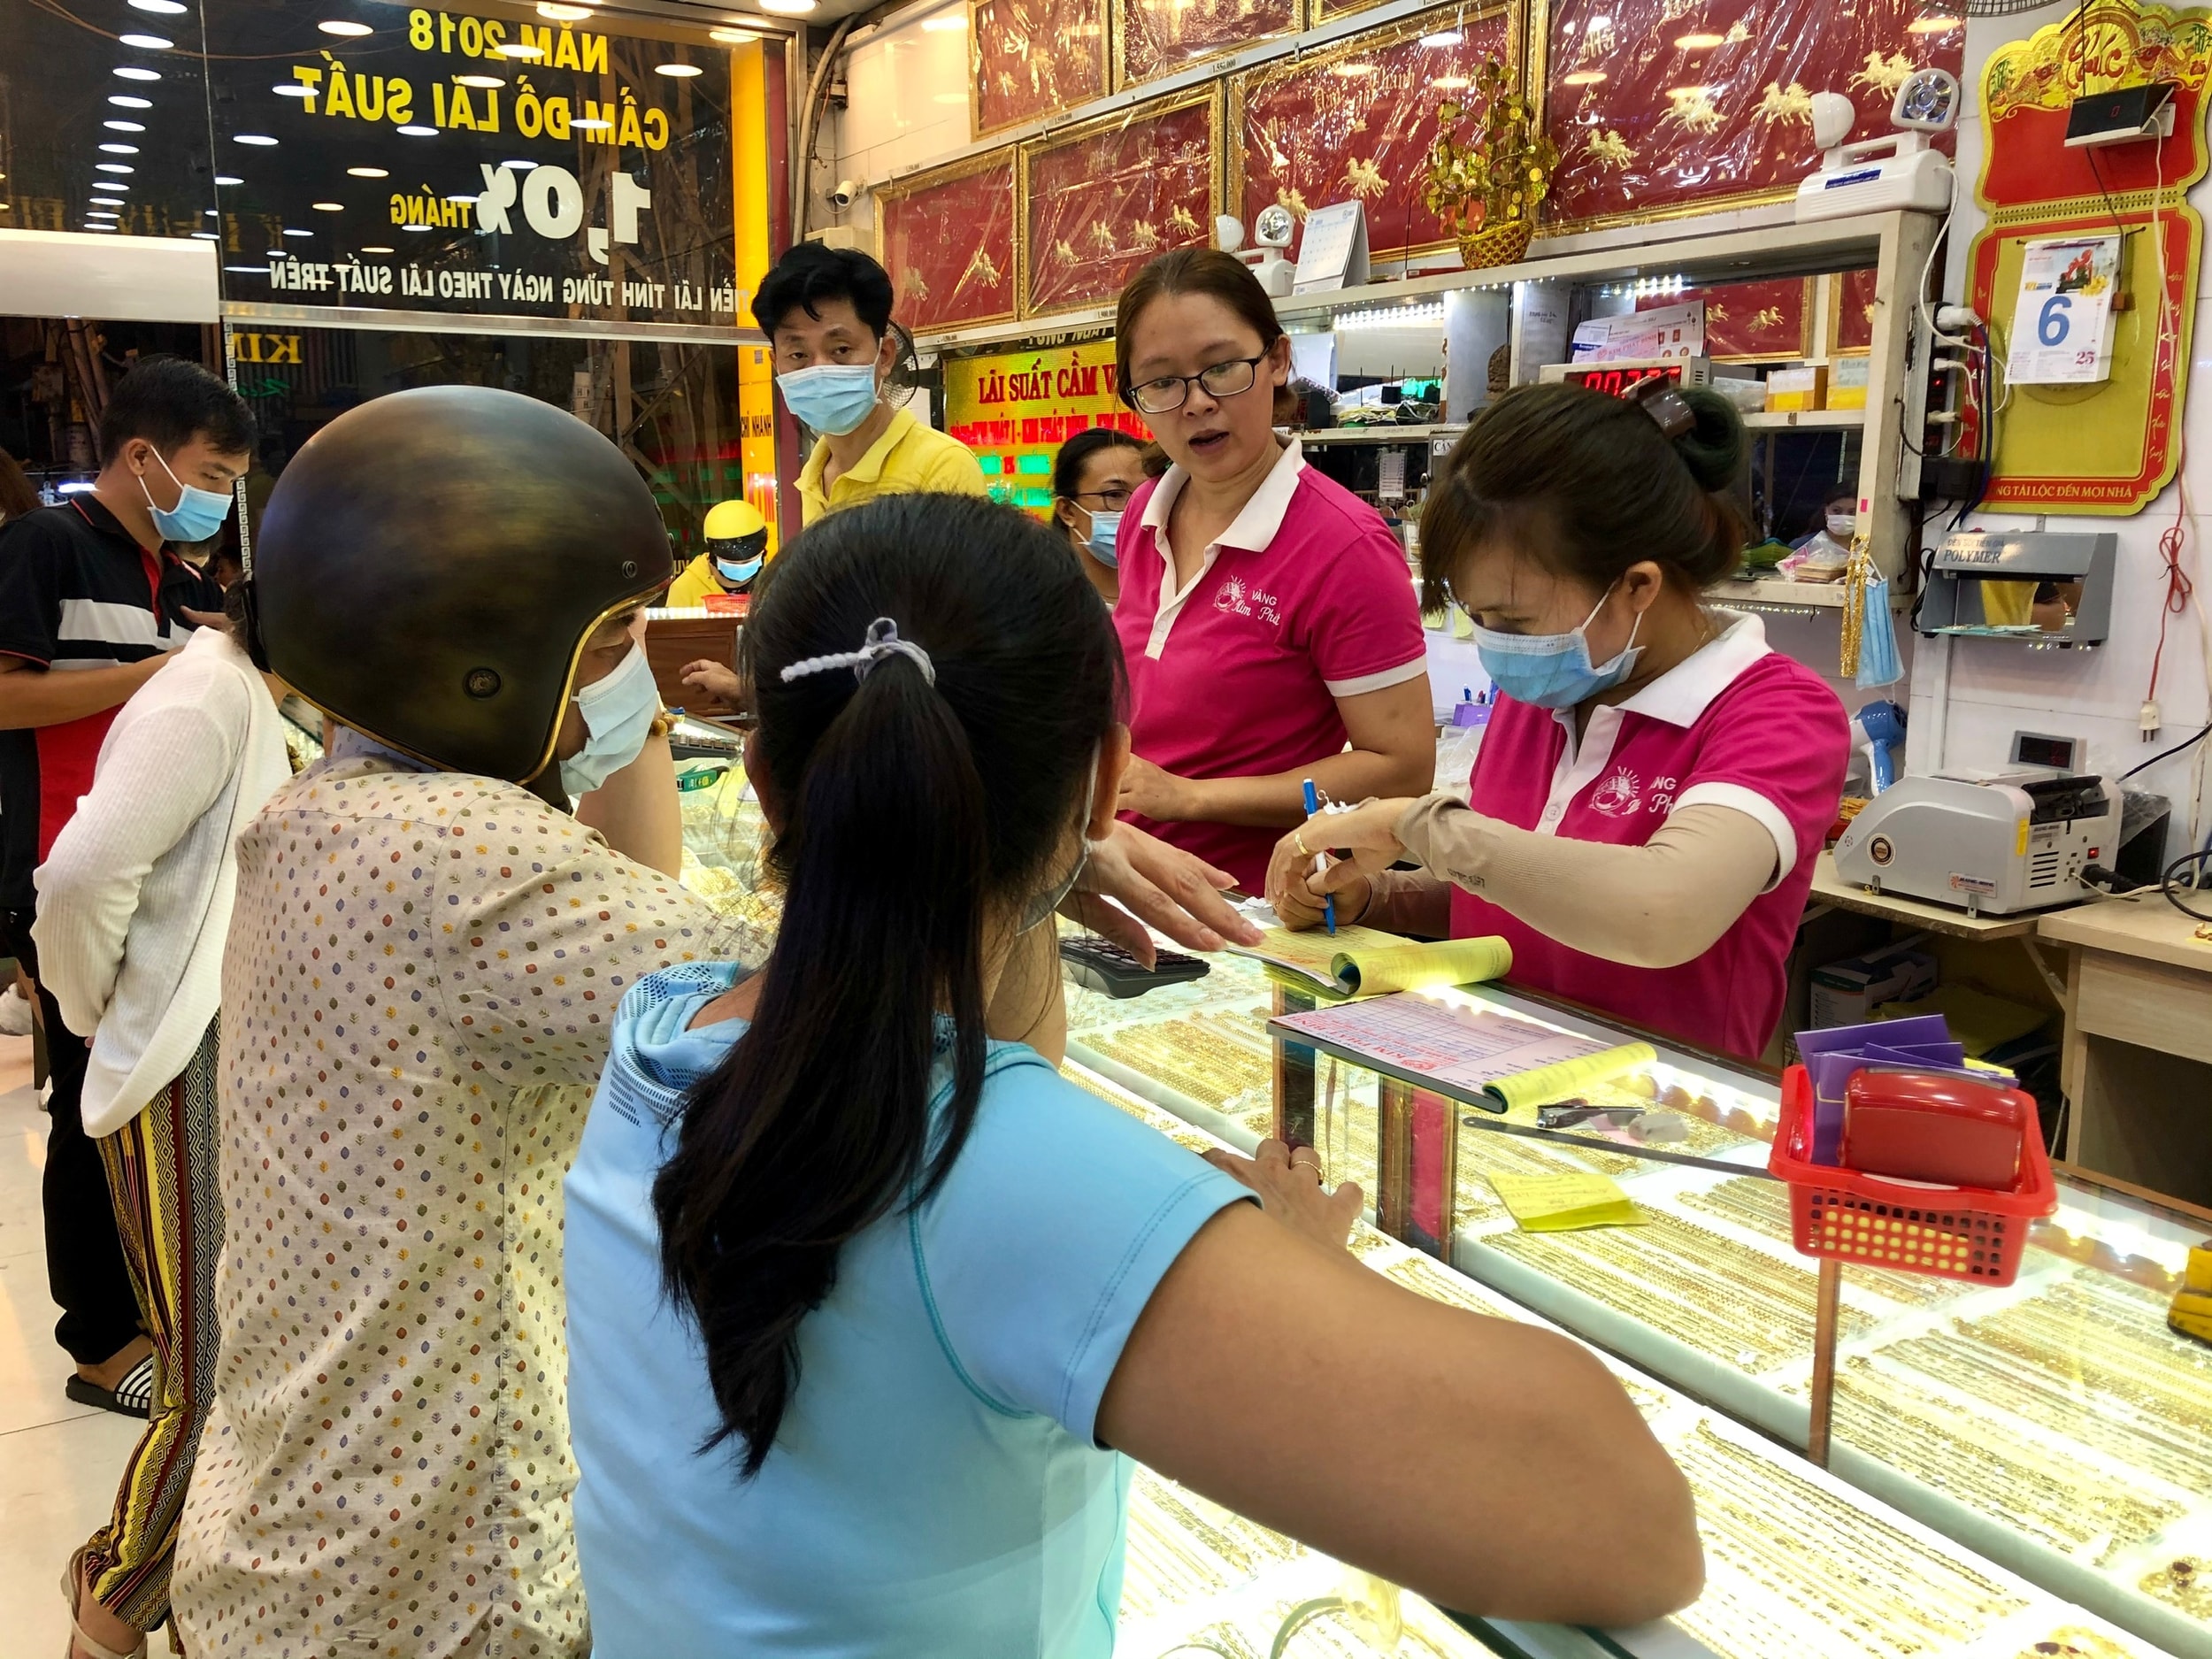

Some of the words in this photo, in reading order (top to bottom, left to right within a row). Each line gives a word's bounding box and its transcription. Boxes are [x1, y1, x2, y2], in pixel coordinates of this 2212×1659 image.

[2038, 295, 2072, 347] 6
[2076, 351, 2096, 365] 25
[979, 369, 1005, 403] LÃI
[1009, 357, 1052, 402] SUẤT
[1057, 350, 1098, 398] CẦM
[2032, 483, 2055, 498] LỘC
[2056, 483, 2079, 496] ĐẾN
[2081, 487, 2108, 498] MỌI
[1943, 549, 2001, 564] POLYMER
[1252, 588, 1278, 606] VÀNG
